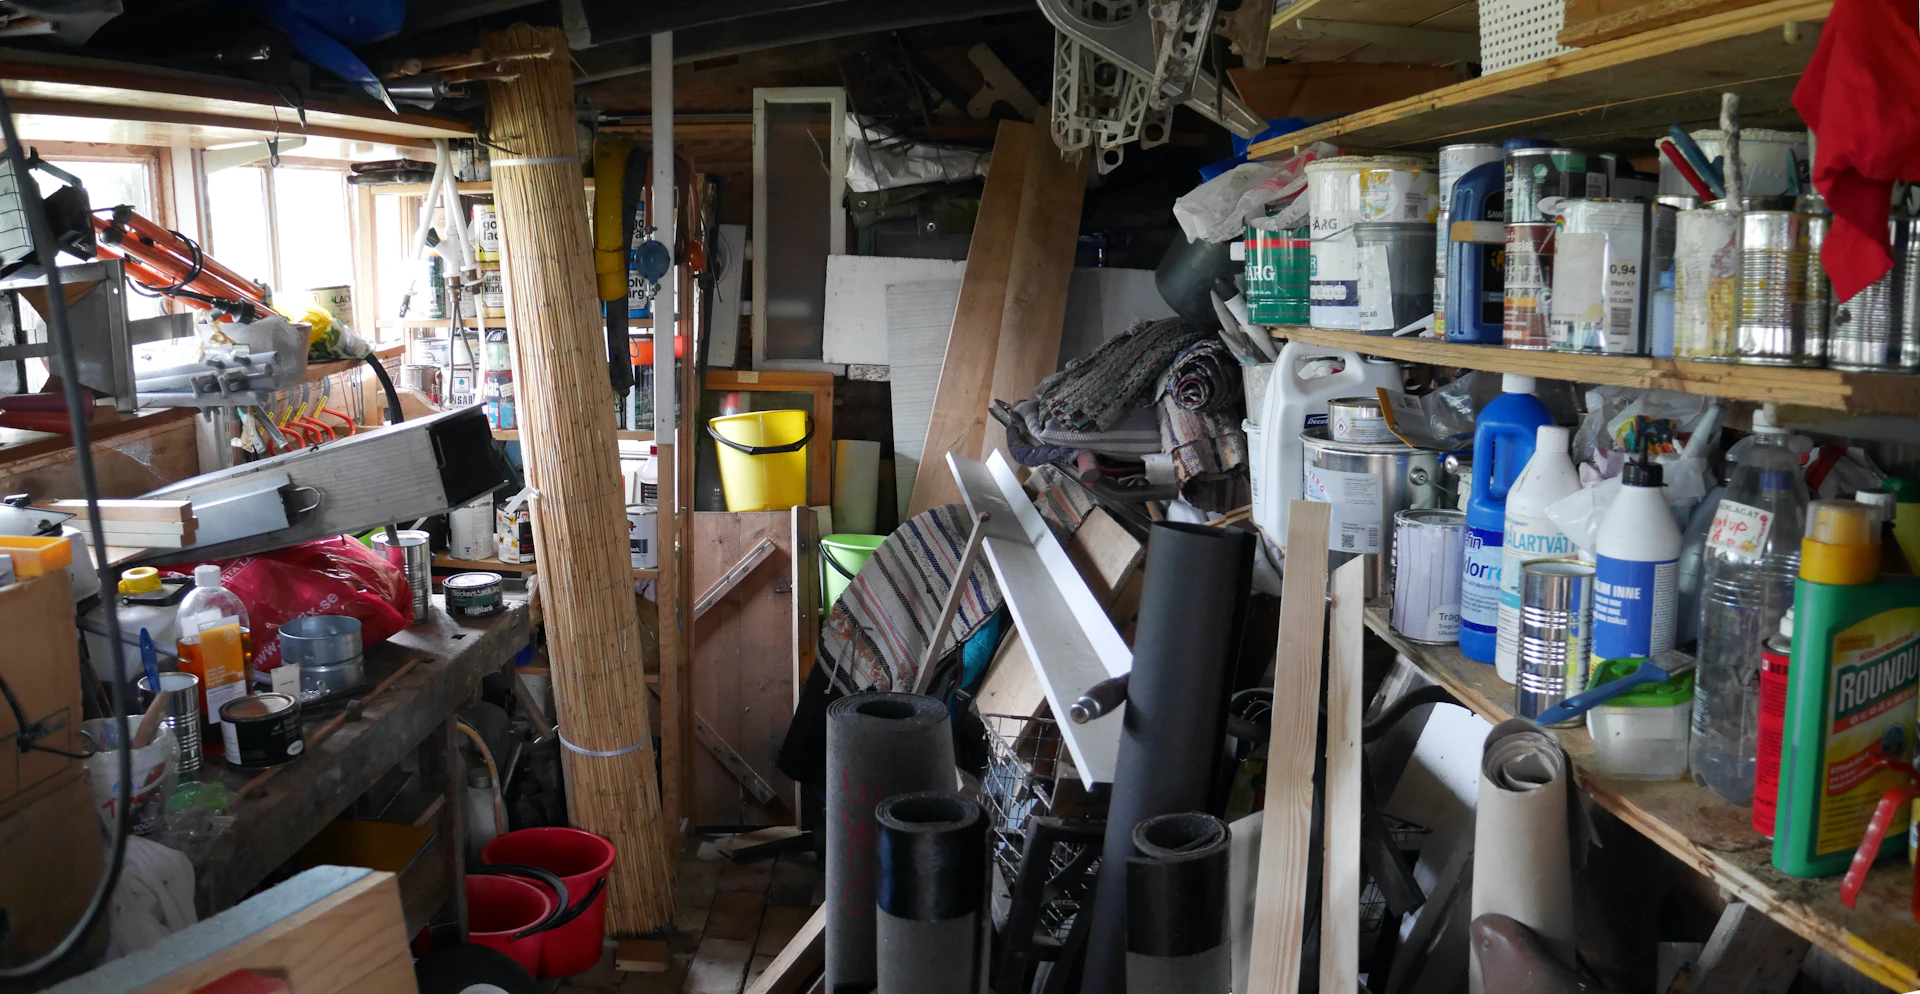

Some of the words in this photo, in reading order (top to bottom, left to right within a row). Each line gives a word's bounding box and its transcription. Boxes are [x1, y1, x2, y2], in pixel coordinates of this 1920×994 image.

[1313, 217, 1338, 230] ÄRG
[1245, 262, 1276, 281] ÄRG
[1610, 264, 1637, 276] 0,94
[1612, 585, 1641, 600] INNE
